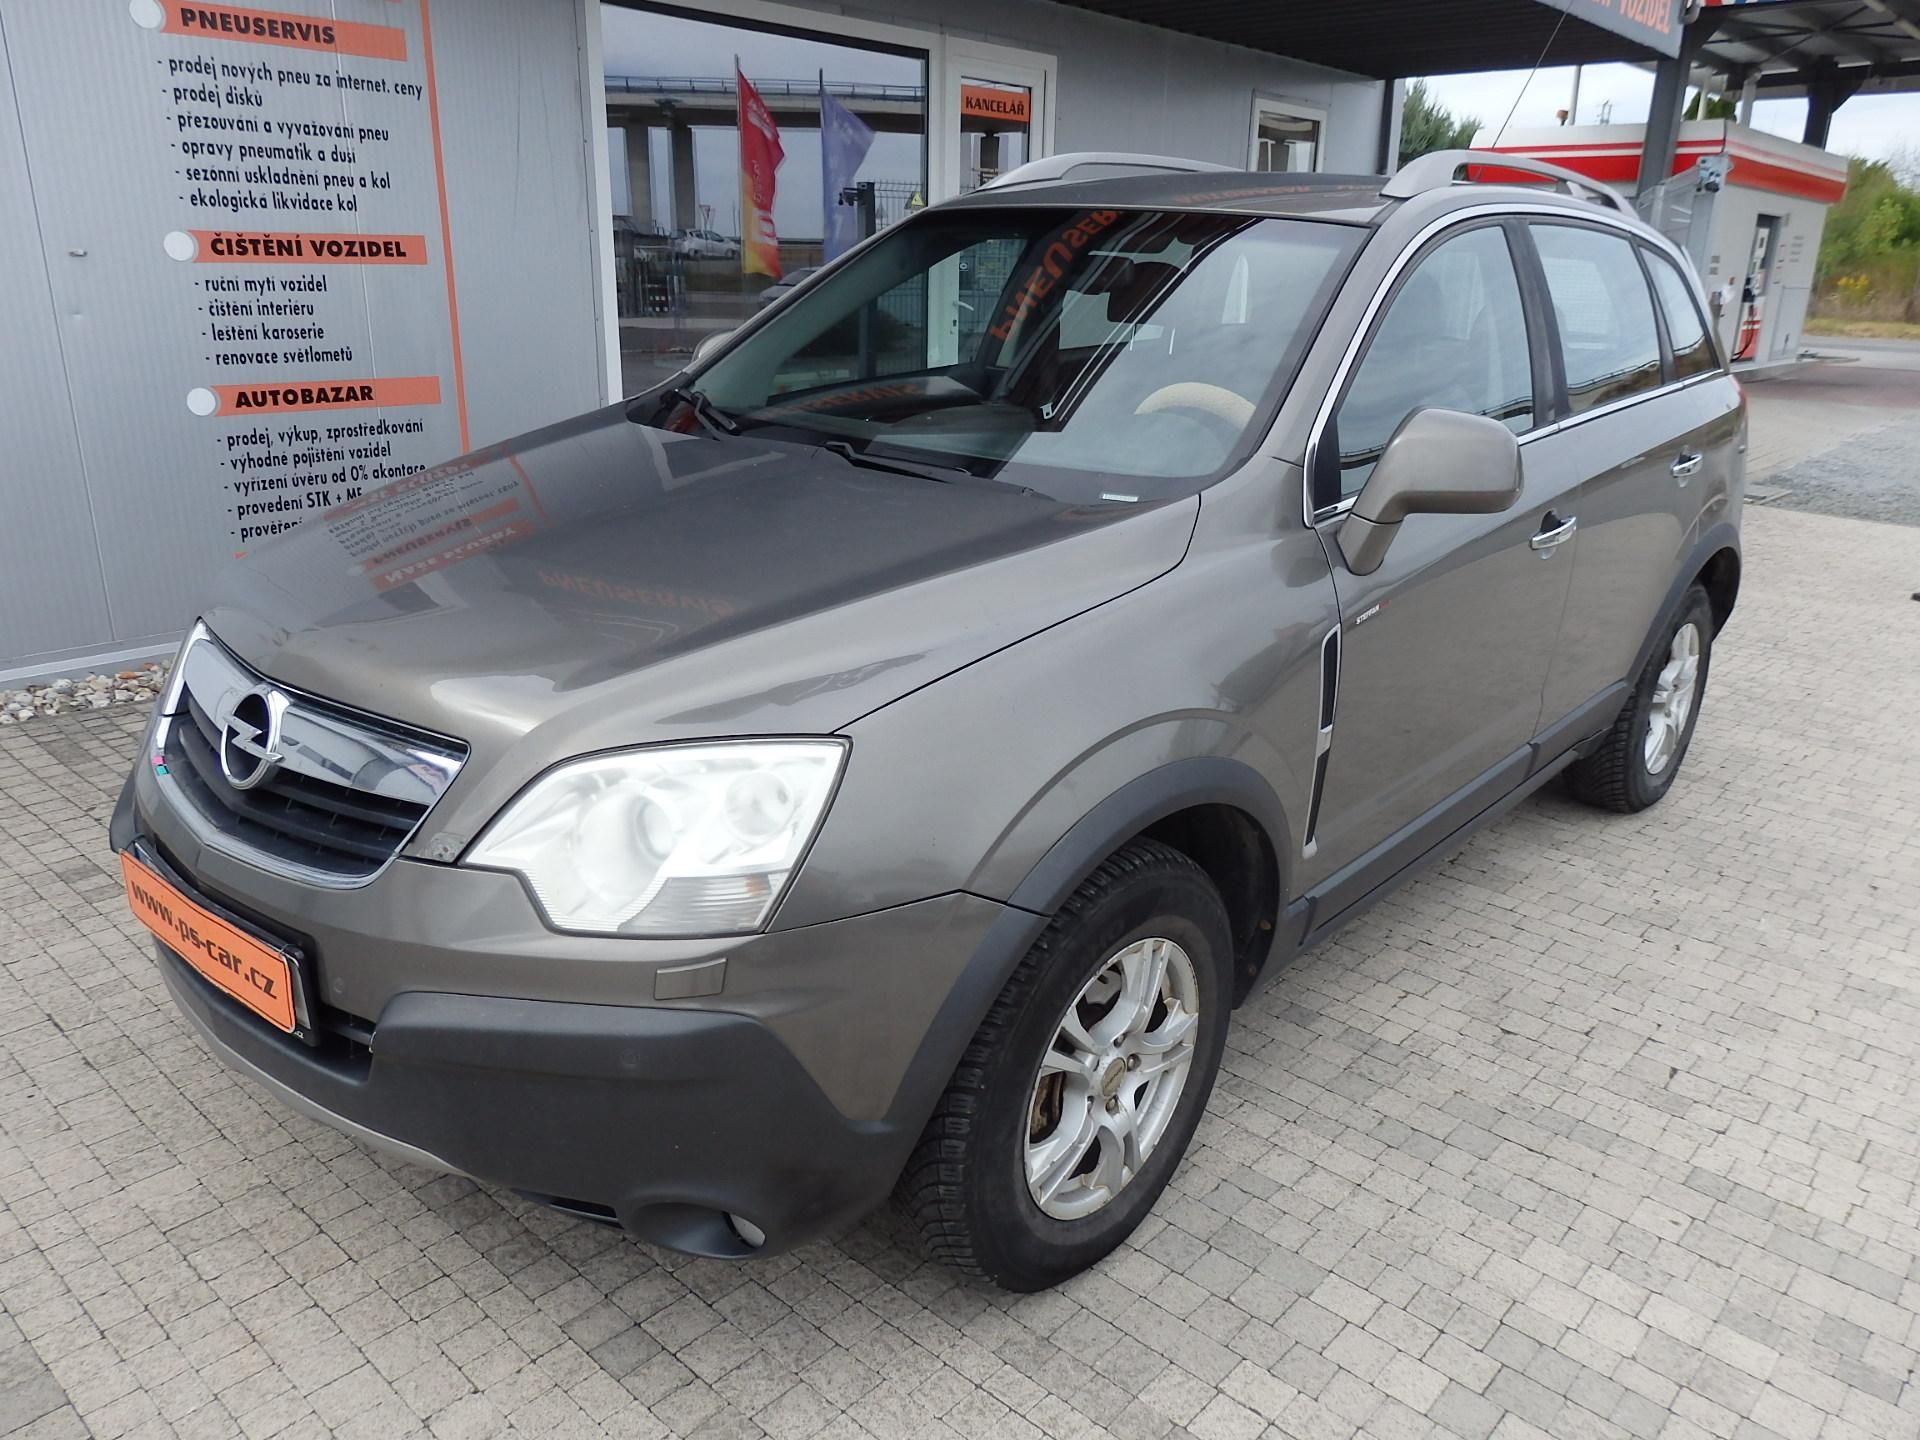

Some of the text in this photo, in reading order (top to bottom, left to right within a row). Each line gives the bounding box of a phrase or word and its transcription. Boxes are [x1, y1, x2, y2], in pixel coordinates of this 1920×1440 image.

[181, 7, 336, 45] PNEUSERVIS
[168, 55, 423, 101] prodej nových pneu za internet. ceny
[173, 83, 221, 108] prodej
[965, 95, 1025, 116] KANCELÁŘ
[178, 111, 389, 144] přezouvání a vyvažování pneu
[182, 141, 233, 161] opravy
[239, 142, 312, 162] pneumatik
[318, 149, 326, 161] a
[245, 165, 319, 186] uskladnění
[323, 174, 354, 191] pneu
[359, 176, 367, 188] a
[370, 170, 391, 189] kol
[190, 187, 358, 213] ekologická likvidace kol
[210, 232, 407, 258] ČIŠTĚNÍ VOZIDEL
[205, 275, 240, 292] ruční
[280, 274, 328, 293] vozidel
[256, 298, 314, 316] interiéru
[211, 322, 325, 342] leštění karoserie
[215, 345, 353, 366] renovace světlometů
[235, 385, 374, 409] AUTOBAZAR
[227, 418, 424, 451] prodej, výkup, zprostředkování
[230, 440, 392, 474] výhodné pojištění vozidel
[291, 471, 328, 488] úvěru
[331, 466, 347, 484] od
[350, 463, 369, 482] 0%
[237, 494, 303, 521] provedení
[306, 490, 332, 509] STK
[336, 493, 342, 503] +
[241, 516, 303, 544] prověře
[131, 880, 278, 1000] www.ps-car.cz
